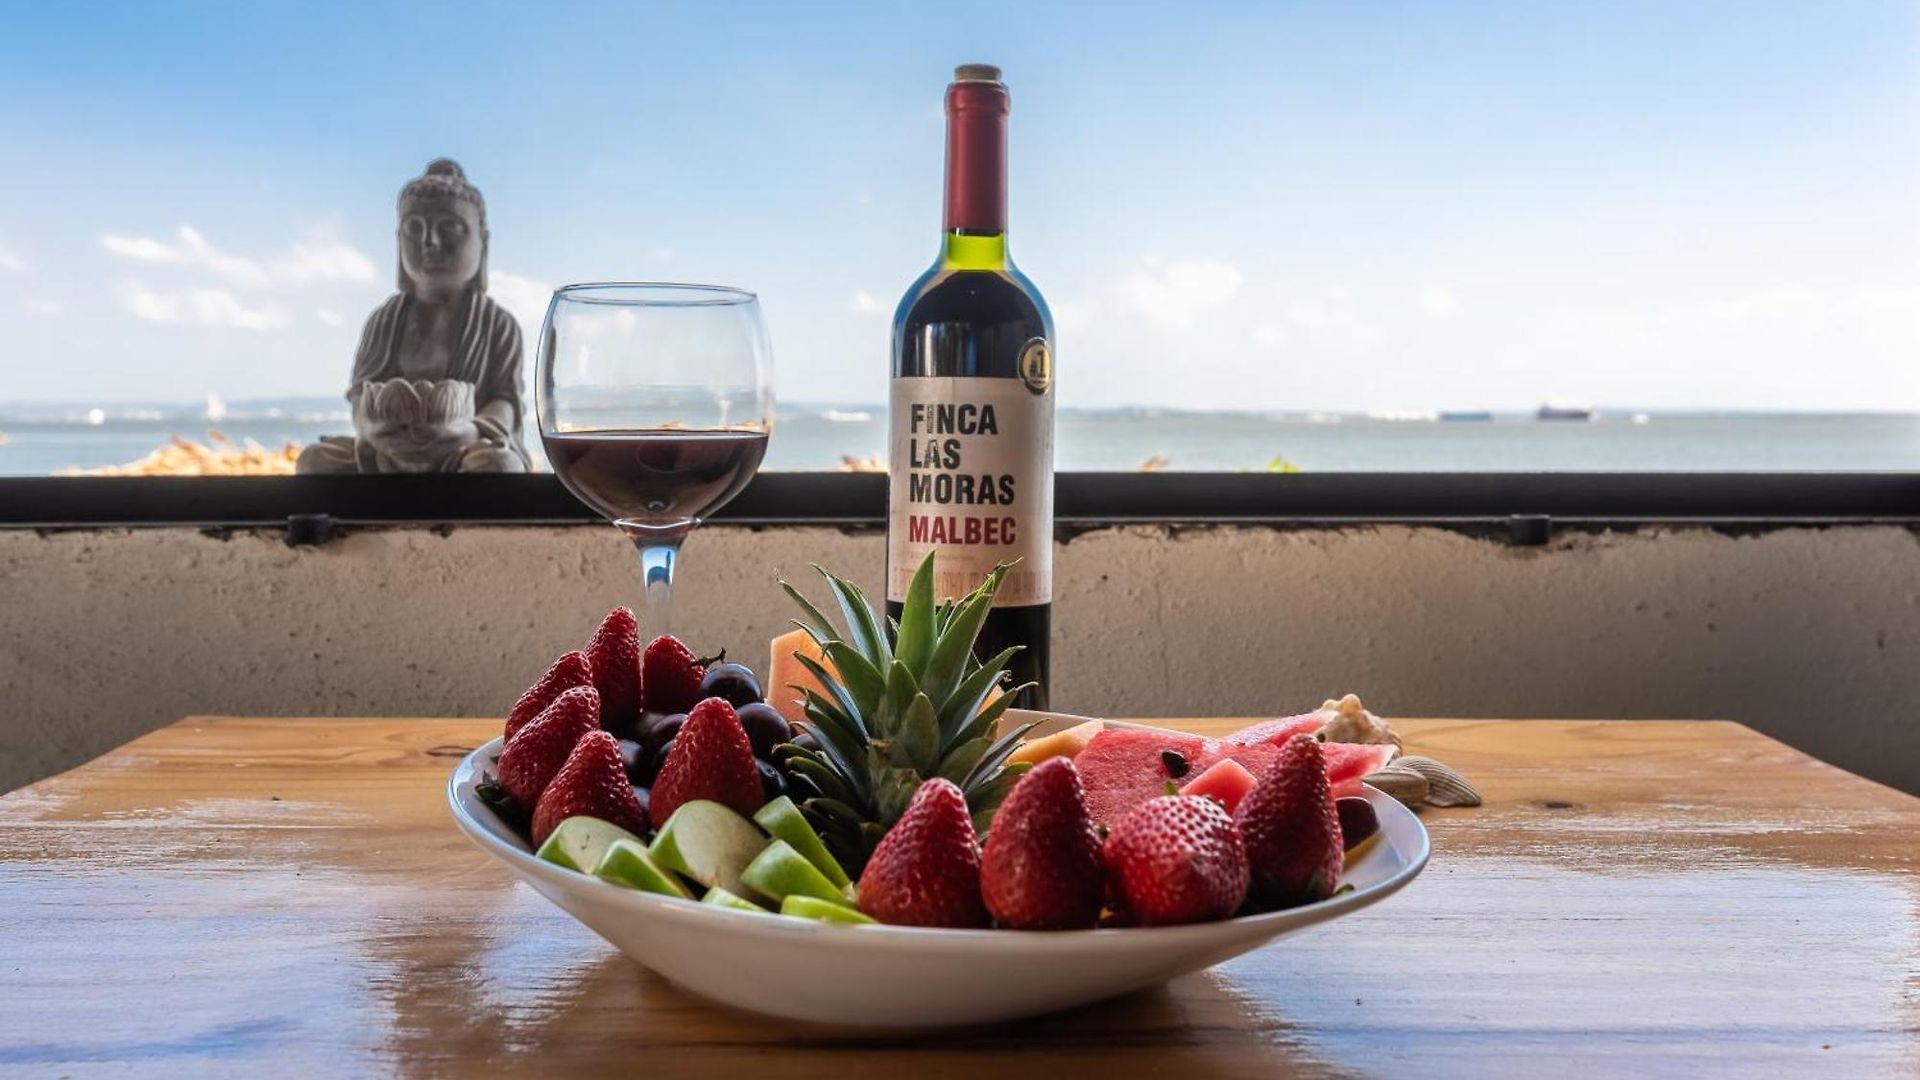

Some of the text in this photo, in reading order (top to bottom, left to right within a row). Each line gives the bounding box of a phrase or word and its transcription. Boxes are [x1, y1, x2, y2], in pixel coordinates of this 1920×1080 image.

[911, 403, 999, 435] FINCA
[910, 438, 961, 470] LAS
[910, 473, 1015, 505] MORAS
[909, 515, 1017, 545] MALBEC
